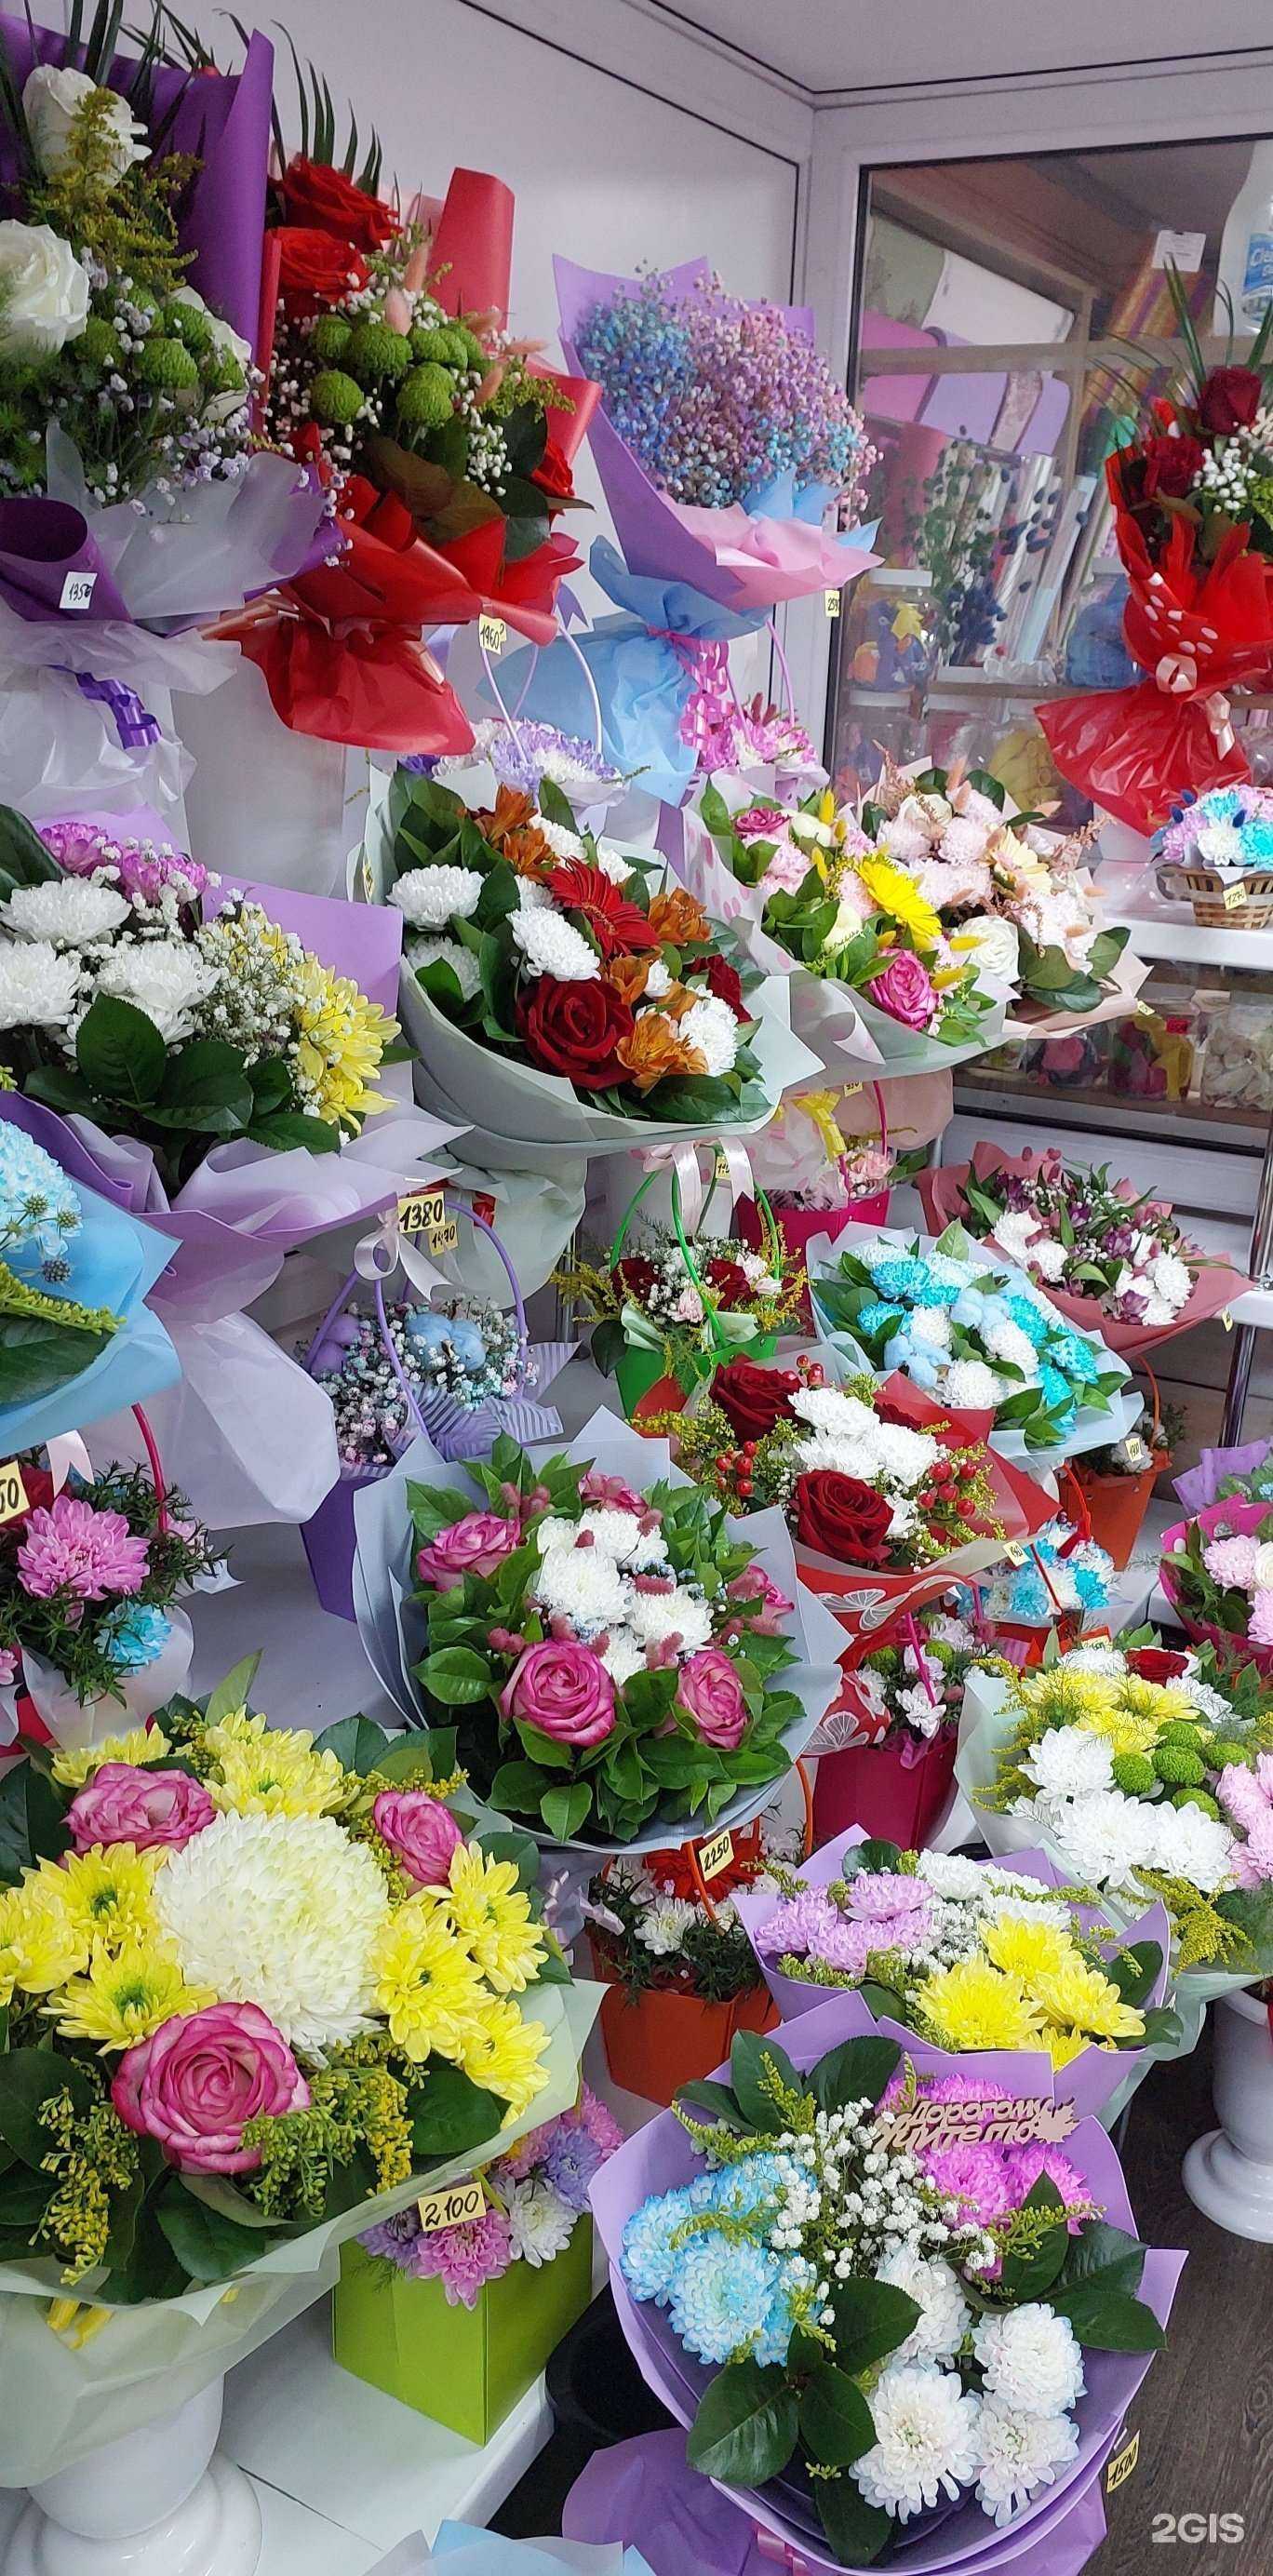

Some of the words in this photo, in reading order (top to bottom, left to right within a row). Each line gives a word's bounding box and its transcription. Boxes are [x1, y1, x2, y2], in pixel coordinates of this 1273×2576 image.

[399, 1199, 443, 1231] 1380
[704, 1836, 730, 1872] 2250
[424, 2191, 479, 2227] 2100
[1108, 2441, 1137, 2486] 1500
